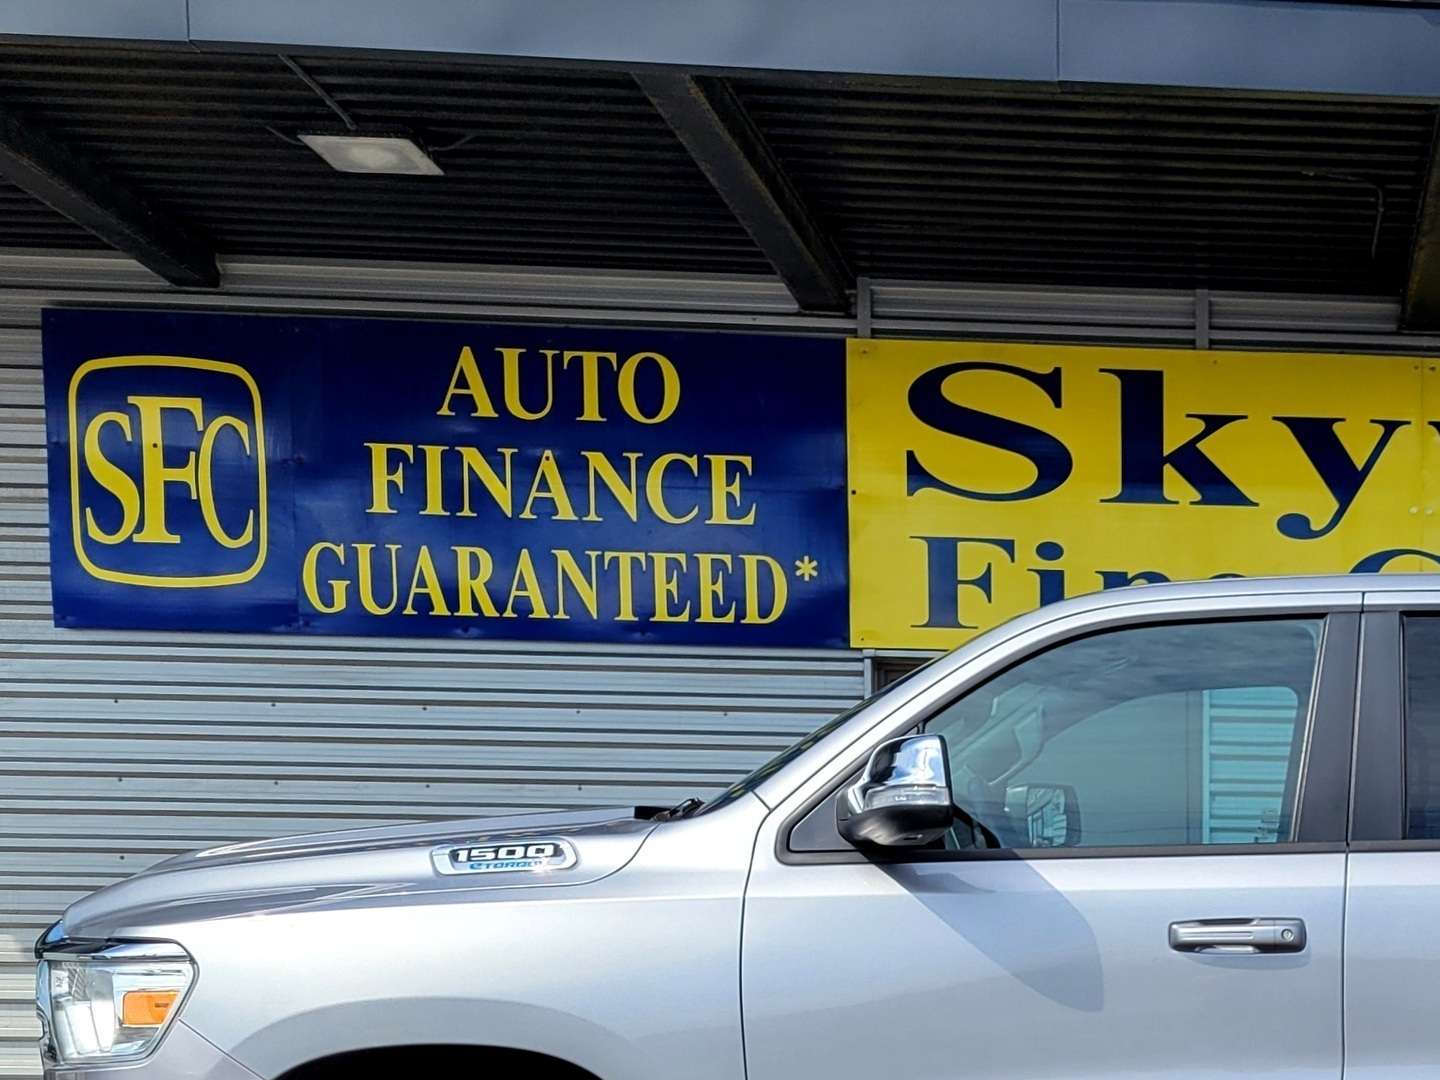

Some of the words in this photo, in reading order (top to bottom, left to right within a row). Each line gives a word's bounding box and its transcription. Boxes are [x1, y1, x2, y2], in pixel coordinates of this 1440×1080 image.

[436, 345, 682, 424] AUTO
[84, 395, 255, 549] SFC
[364, 442, 757, 526] FINANCE
[456, 843, 555, 863] 1500
